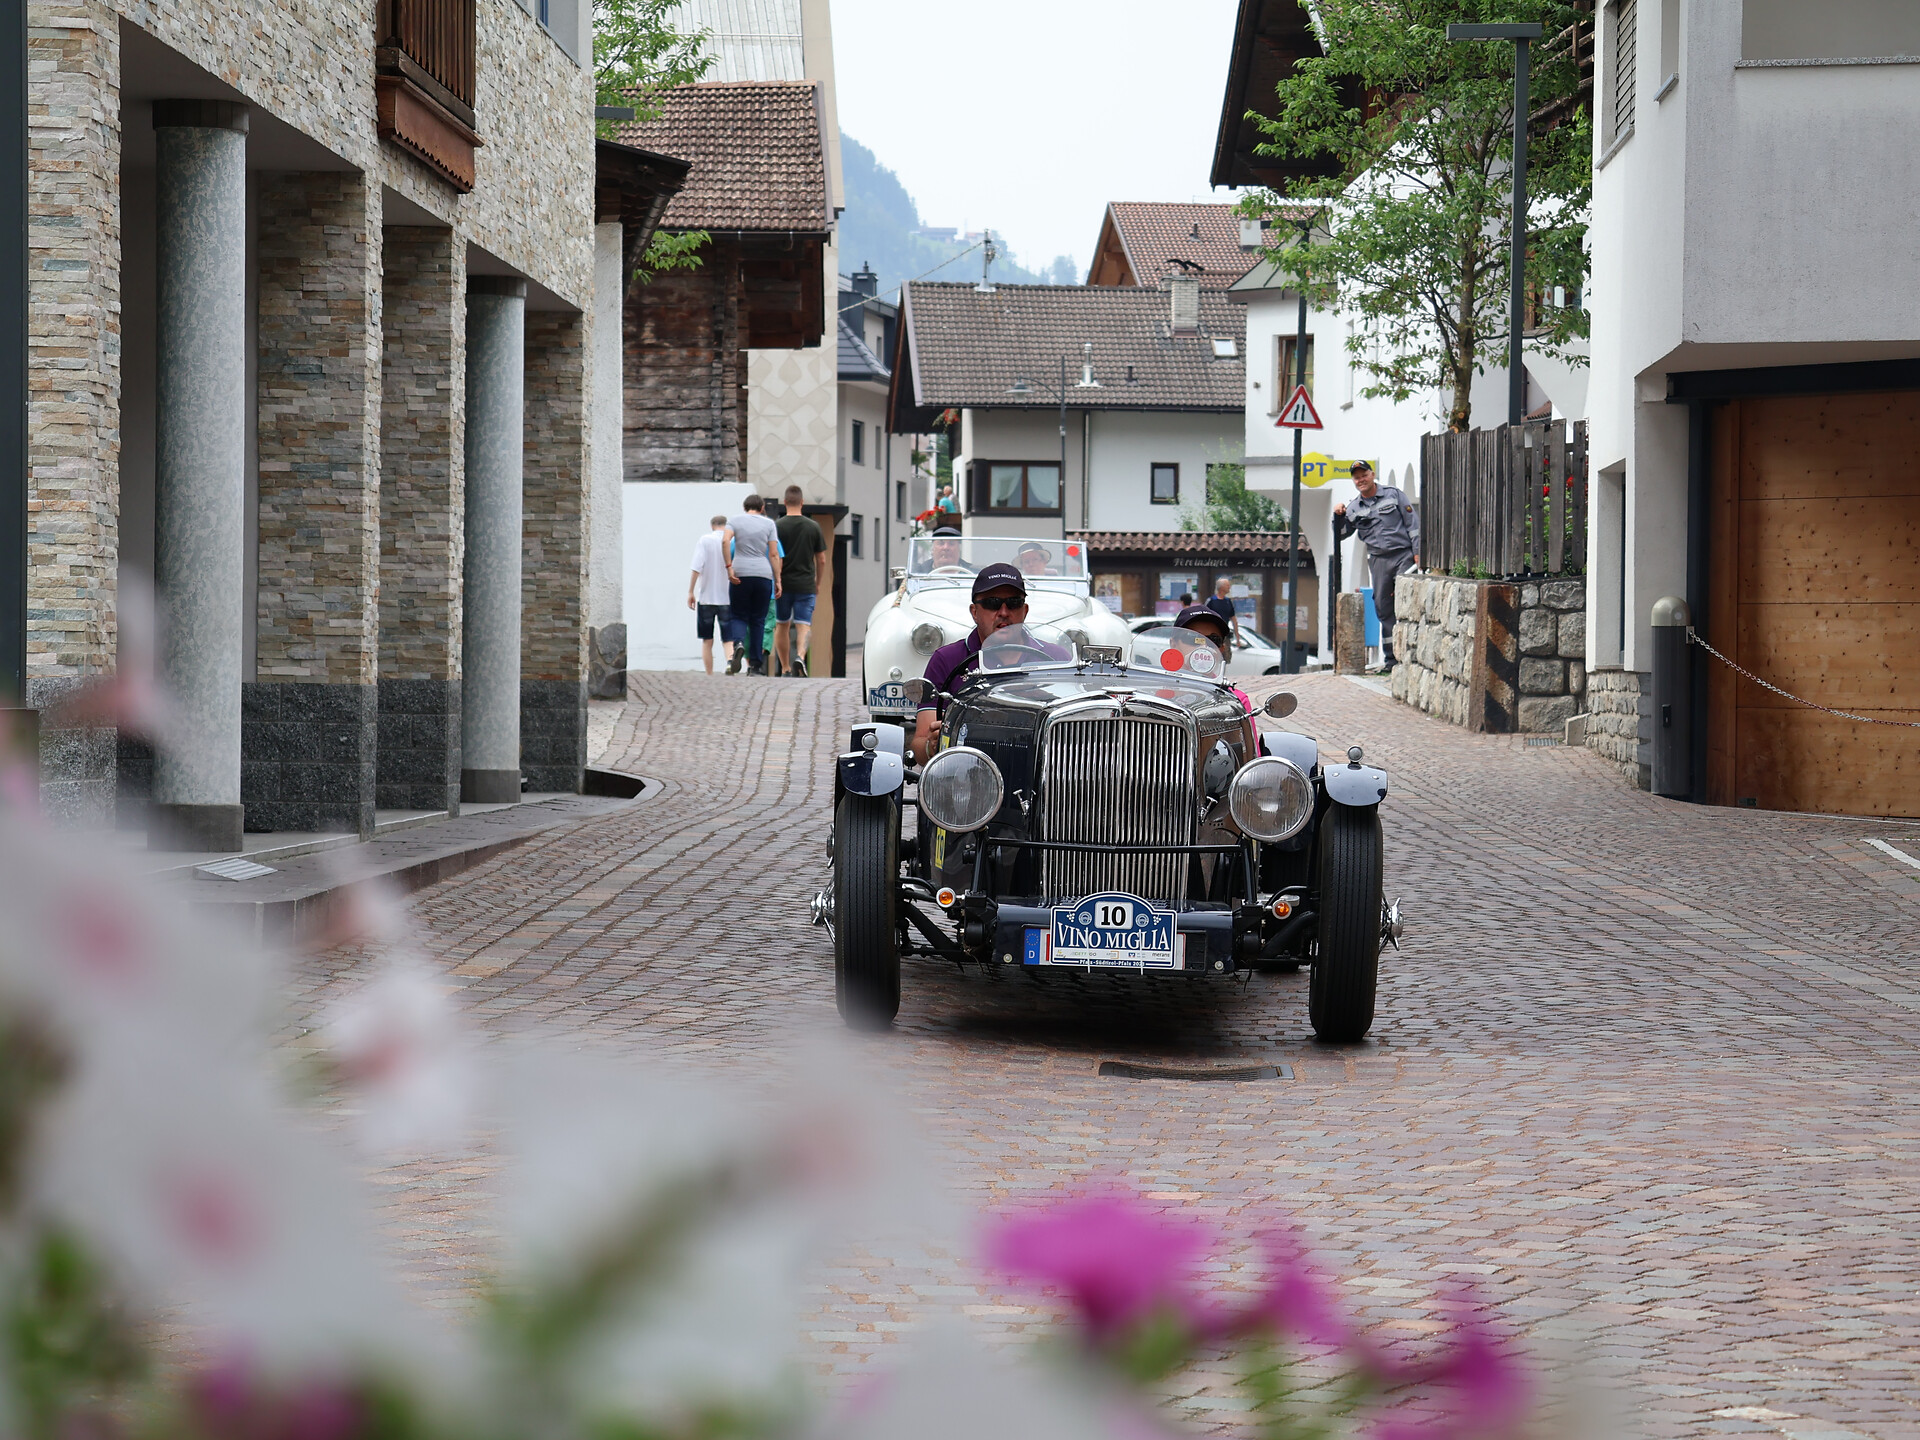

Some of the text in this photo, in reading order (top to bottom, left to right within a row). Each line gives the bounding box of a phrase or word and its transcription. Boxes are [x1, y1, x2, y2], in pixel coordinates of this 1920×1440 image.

[1302, 462, 1328, 477] PT
[891, 687, 898, 697] 9
[871, 694, 890, 707] VINO
[1100, 905, 1127, 927] 10
[1057, 921, 1170, 950] VINO MIGLIA
[1028, 950, 1036, 959] D
[1079, 959, 1131, 967] Pfaz-Südtirol-Pfalz
